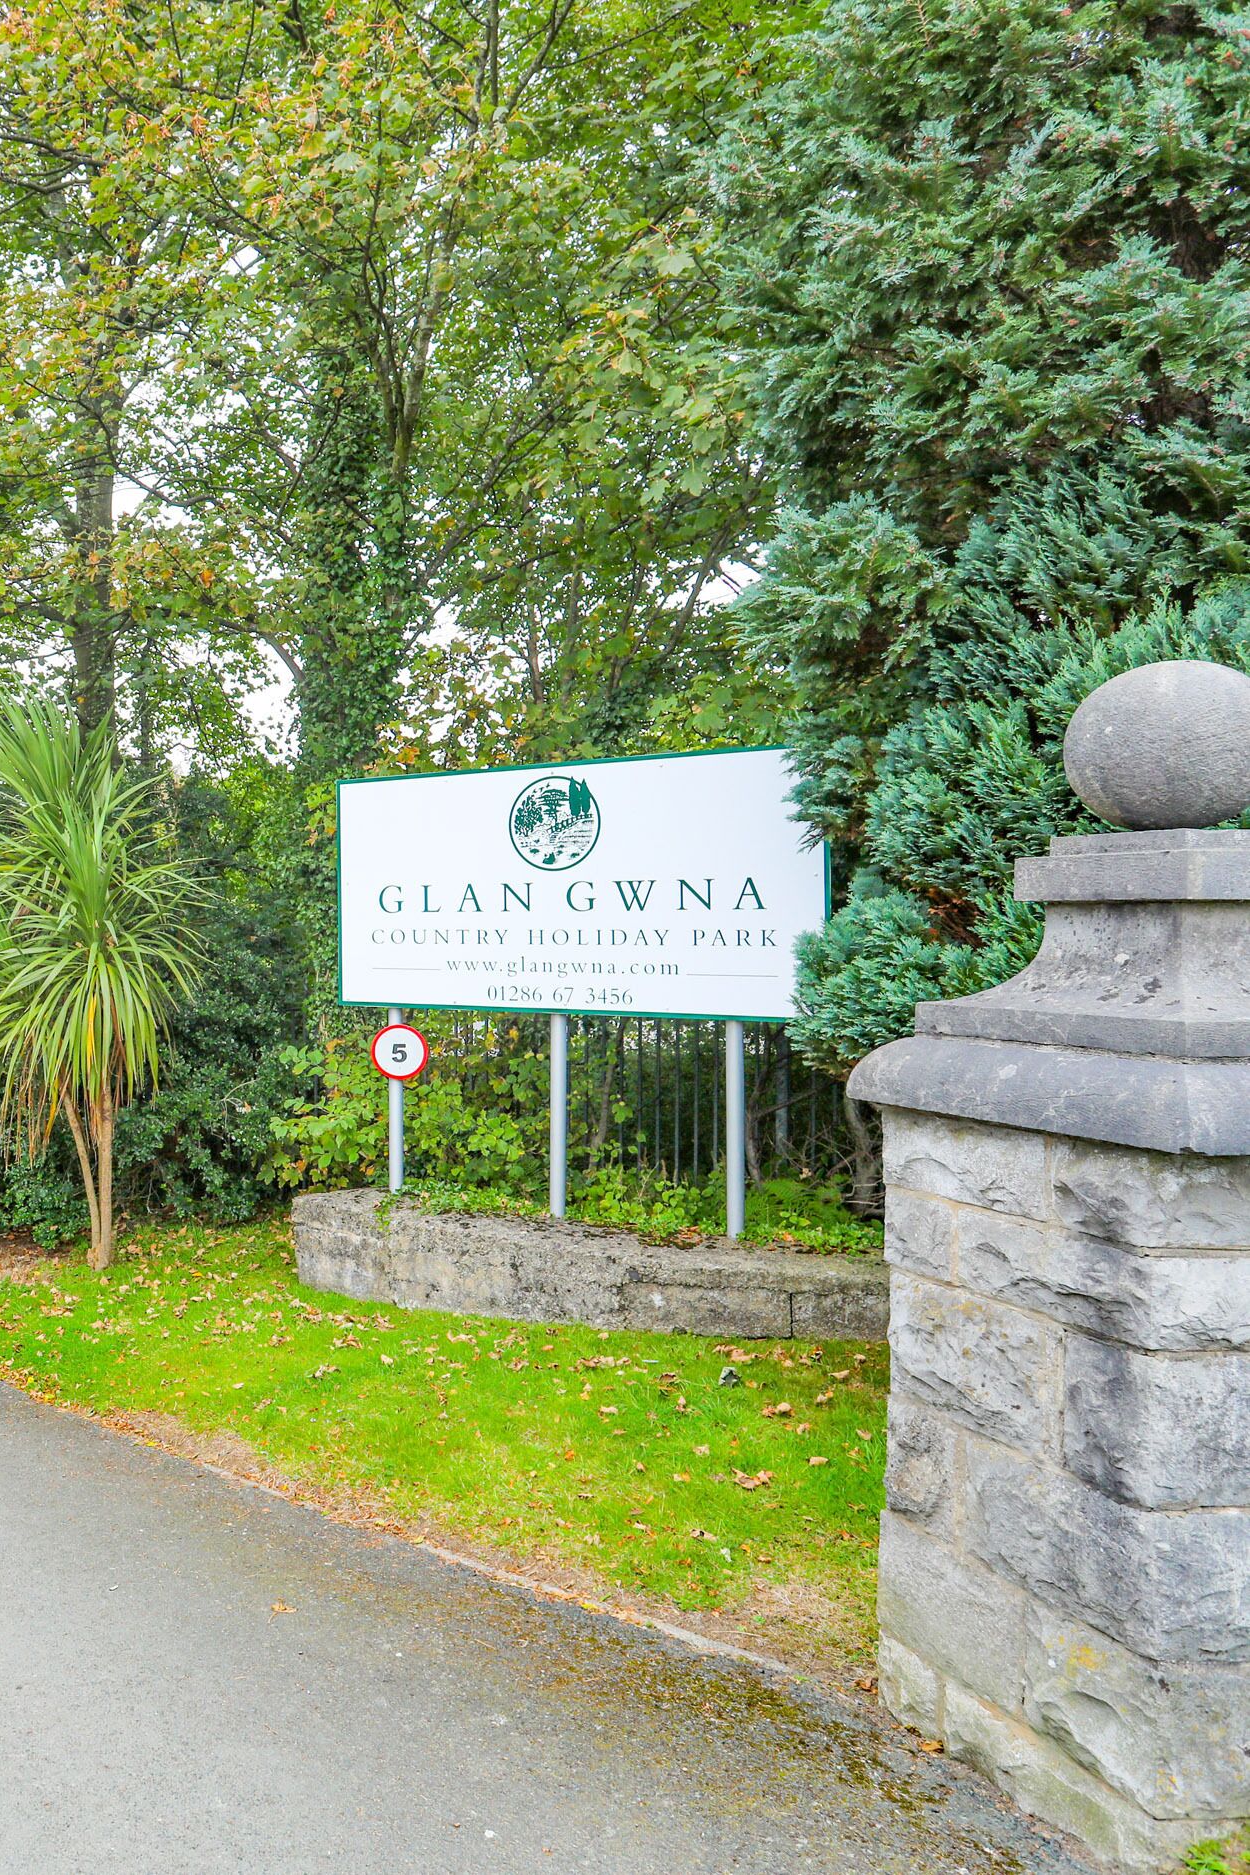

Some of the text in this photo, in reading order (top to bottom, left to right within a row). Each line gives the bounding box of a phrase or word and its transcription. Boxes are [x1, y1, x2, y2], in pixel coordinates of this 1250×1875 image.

[378, 876, 767, 914] GLAN GWNA
[371, 928, 779, 947] COUNTRY HOLIDAY PARK
[446, 957, 680, 977] www.glangwna.com
[487, 985, 634, 1006] 01286 67 3456
[391, 1043, 408, 1063] 5
